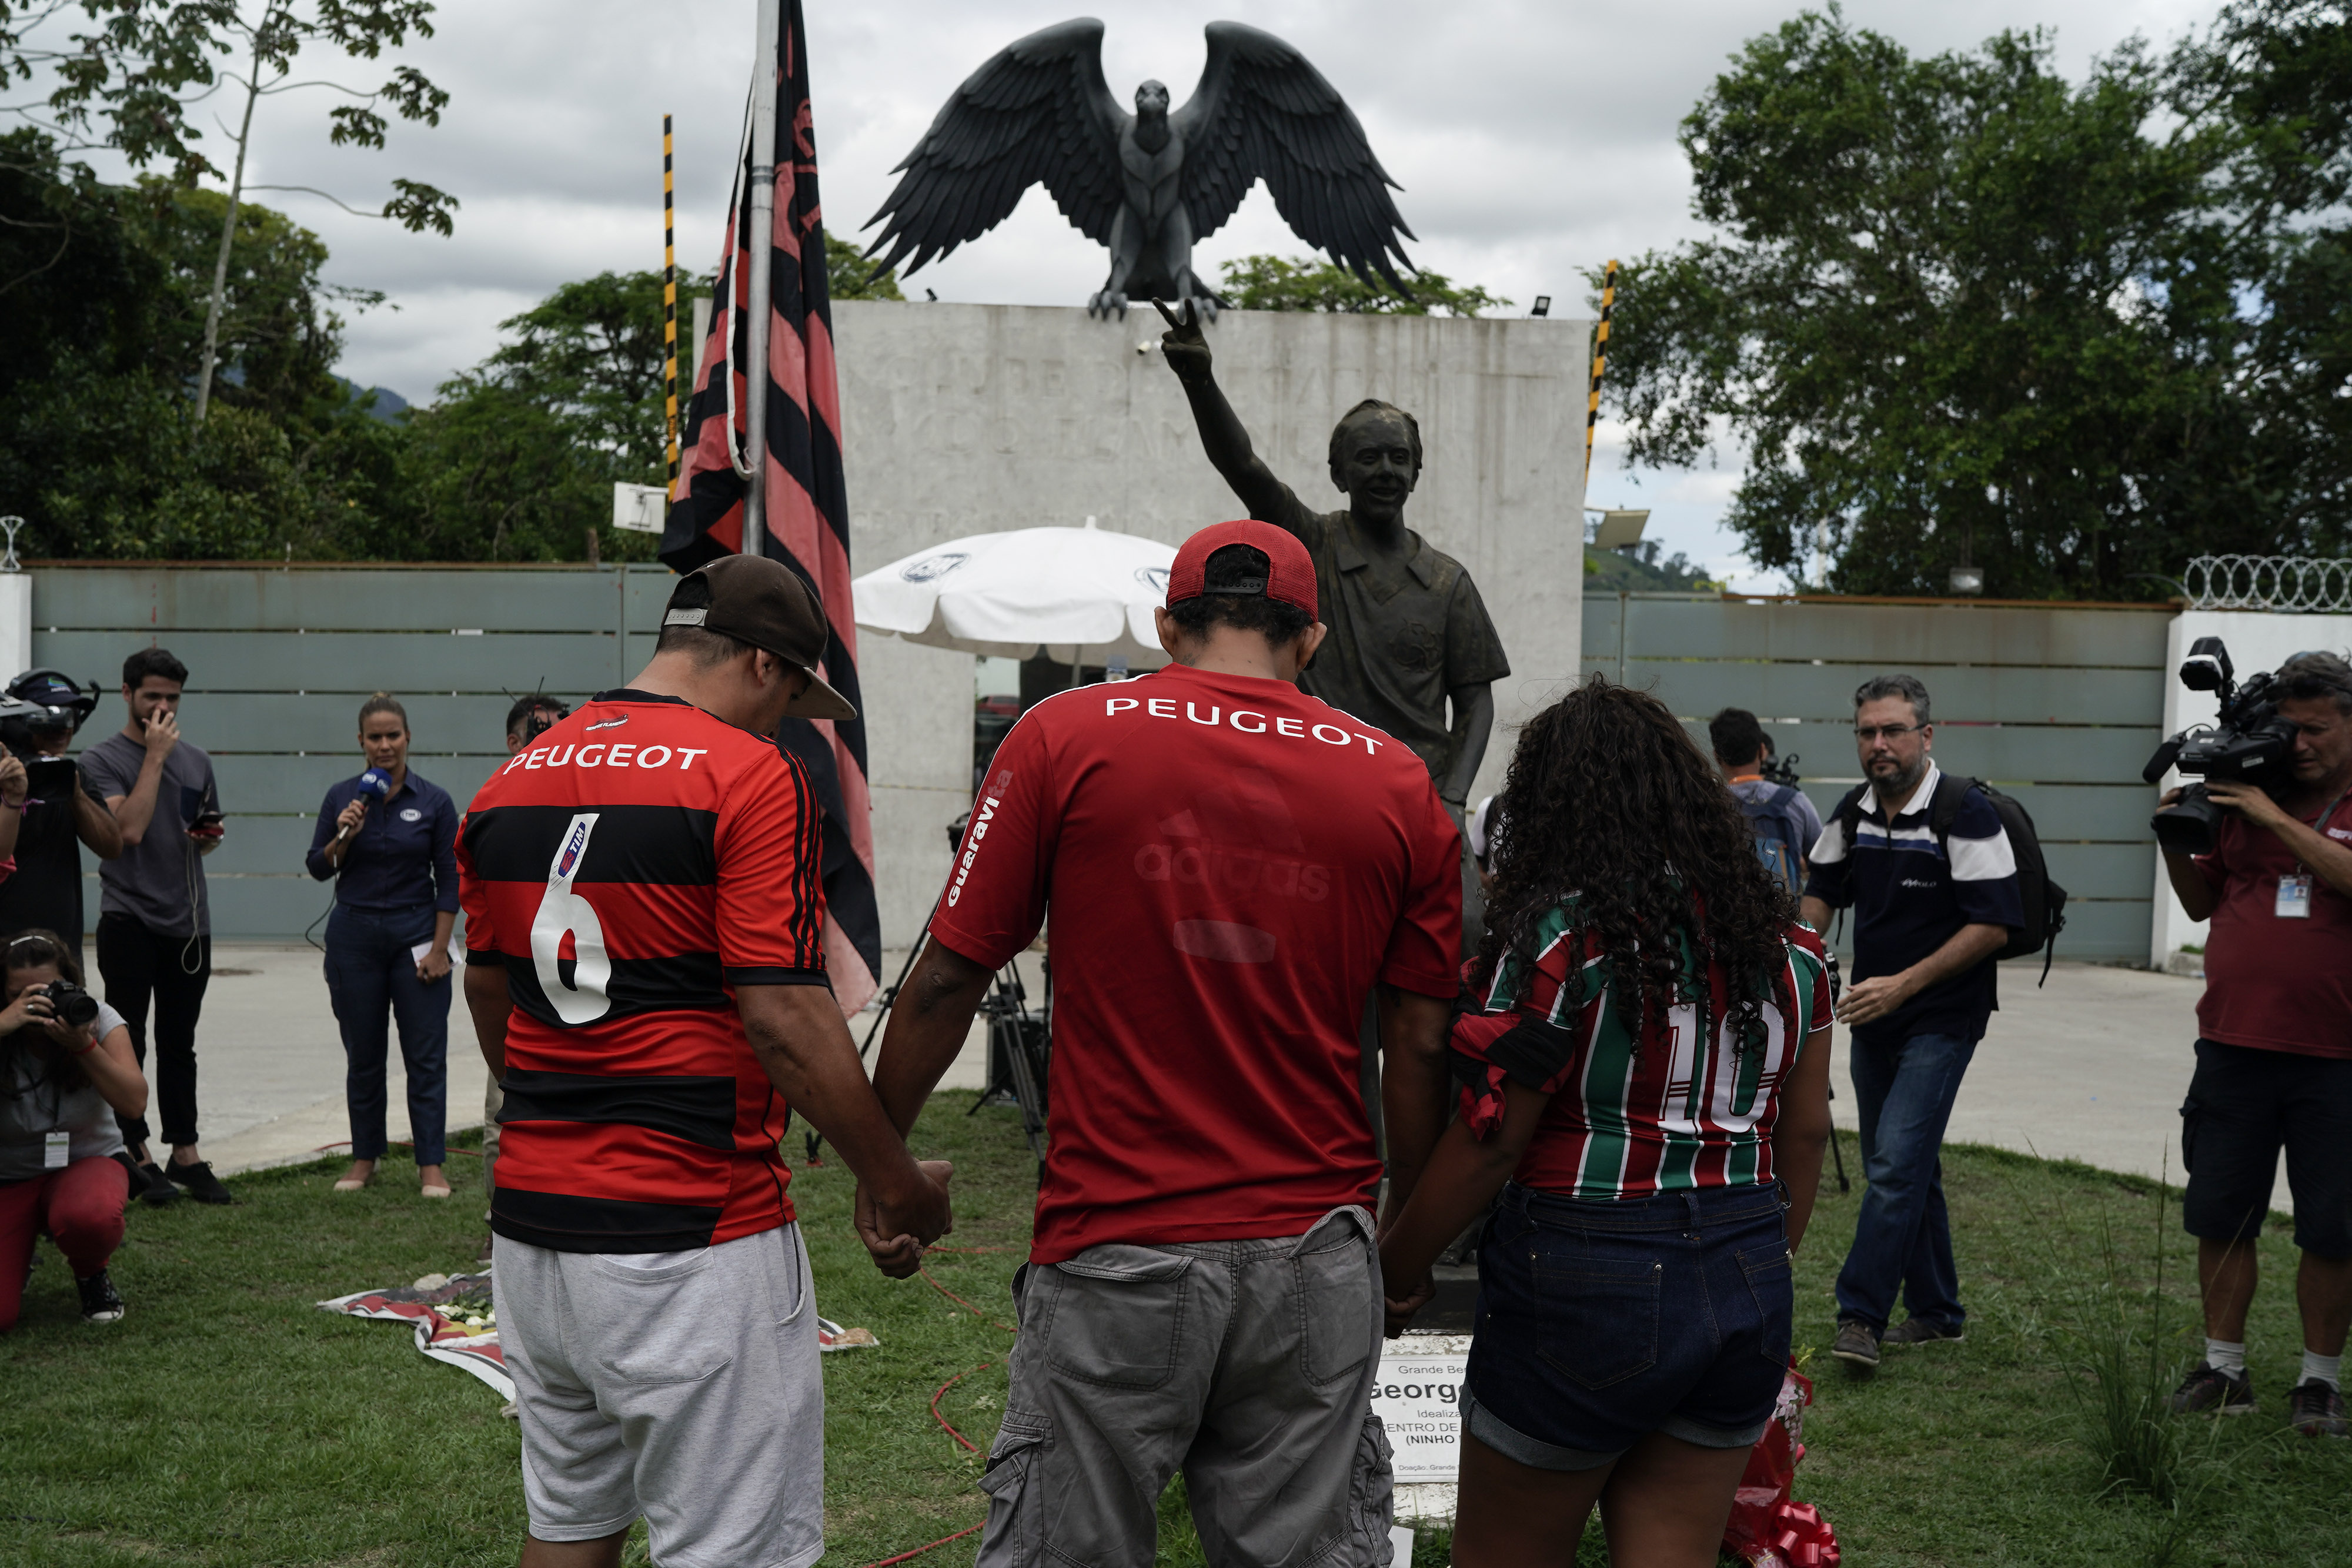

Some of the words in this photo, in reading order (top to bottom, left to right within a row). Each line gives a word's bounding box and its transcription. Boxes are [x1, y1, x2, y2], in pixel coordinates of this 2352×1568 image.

[603, 718, 628, 727] FLAMENGO
[1106, 697, 1383, 755] PEUGEOT
[503, 744, 707, 775] PEUGEOT
[569, 827, 584, 853] TIM
[530, 813, 612, 1024] 6
[1658, 1001, 1785, 1135] 10
[1398, 1365, 1444, 1374] Grande
[1371, 1380, 1464, 1404] Georg
[1440, 1423, 1459, 1432] DE
[1406, 1435, 1455, 1446] (NINHO
